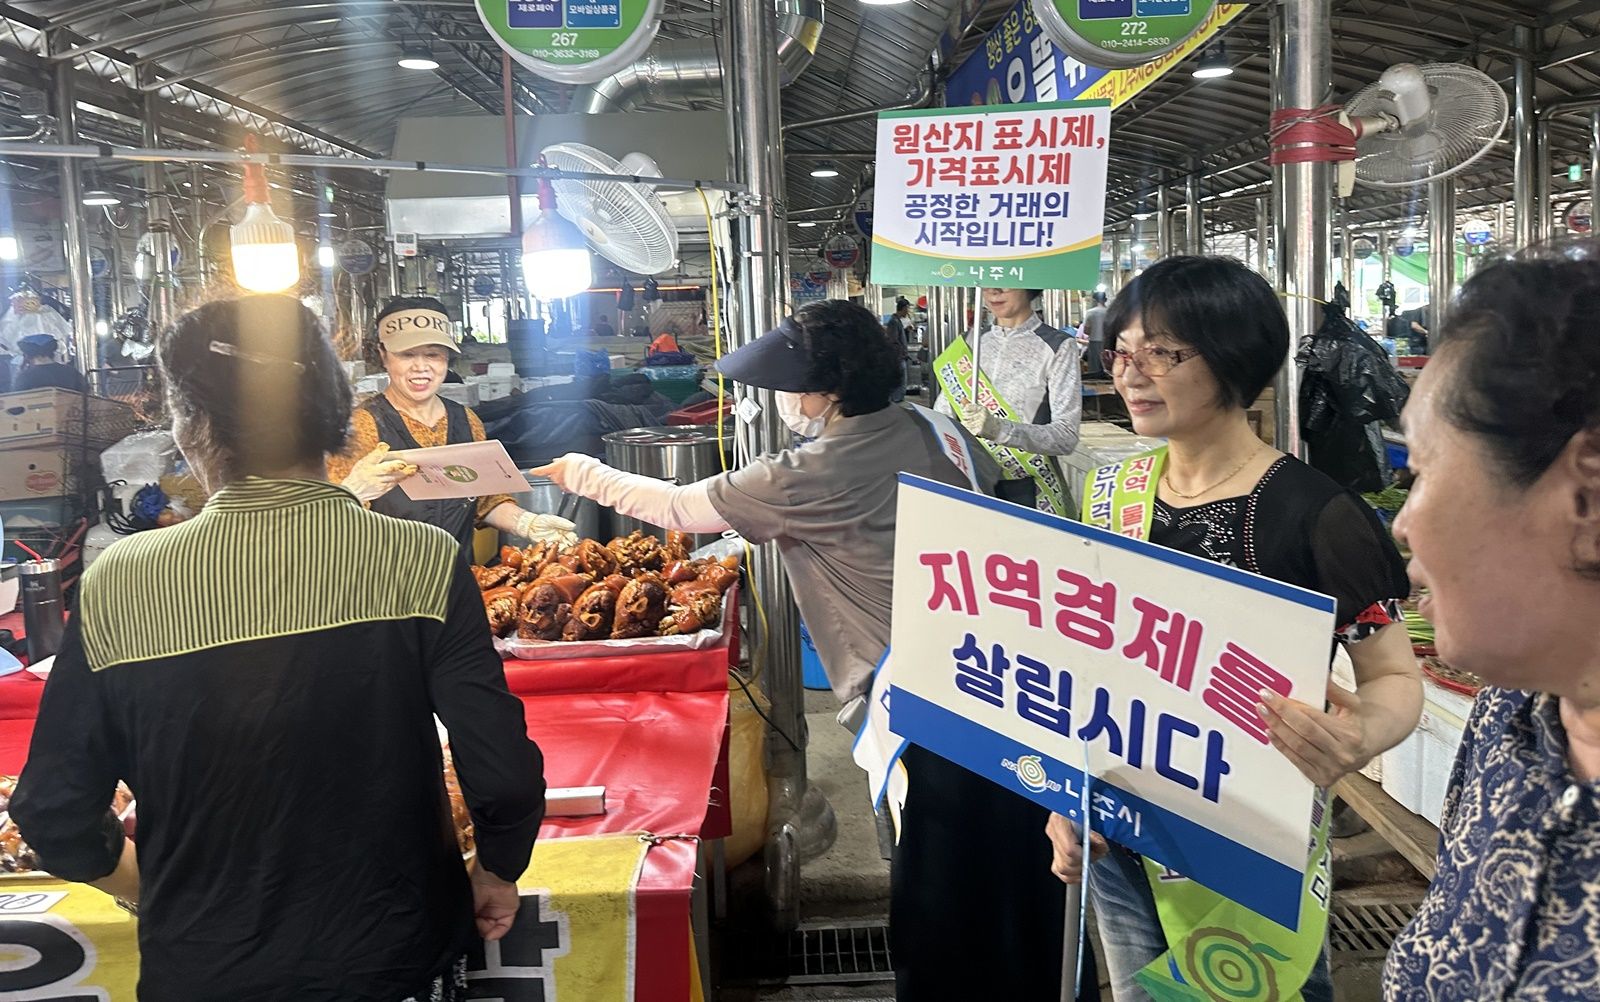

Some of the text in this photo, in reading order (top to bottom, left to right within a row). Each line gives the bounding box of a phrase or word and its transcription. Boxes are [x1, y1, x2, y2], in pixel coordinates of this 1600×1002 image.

[518, 3, 554, 12] 제로페이
[551, 32, 578, 46] 267
[1121, 22, 1148, 36] 272
[893, 114, 1105, 155] 원산지 표시제,
[906, 152, 1072, 188] 가격표시제
[904, 192, 980, 220] 공정한
[989, 191, 1070, 219] 거래의
[914, 221, 1054, 248] 시작입니다!
[969, 265, 1024, 281] 나주시
[1124, 456, 1155, 492] 지역
[918, 549, 1294, 746] 지역경제를
[952, 632, 1232, 805] 살립시다
